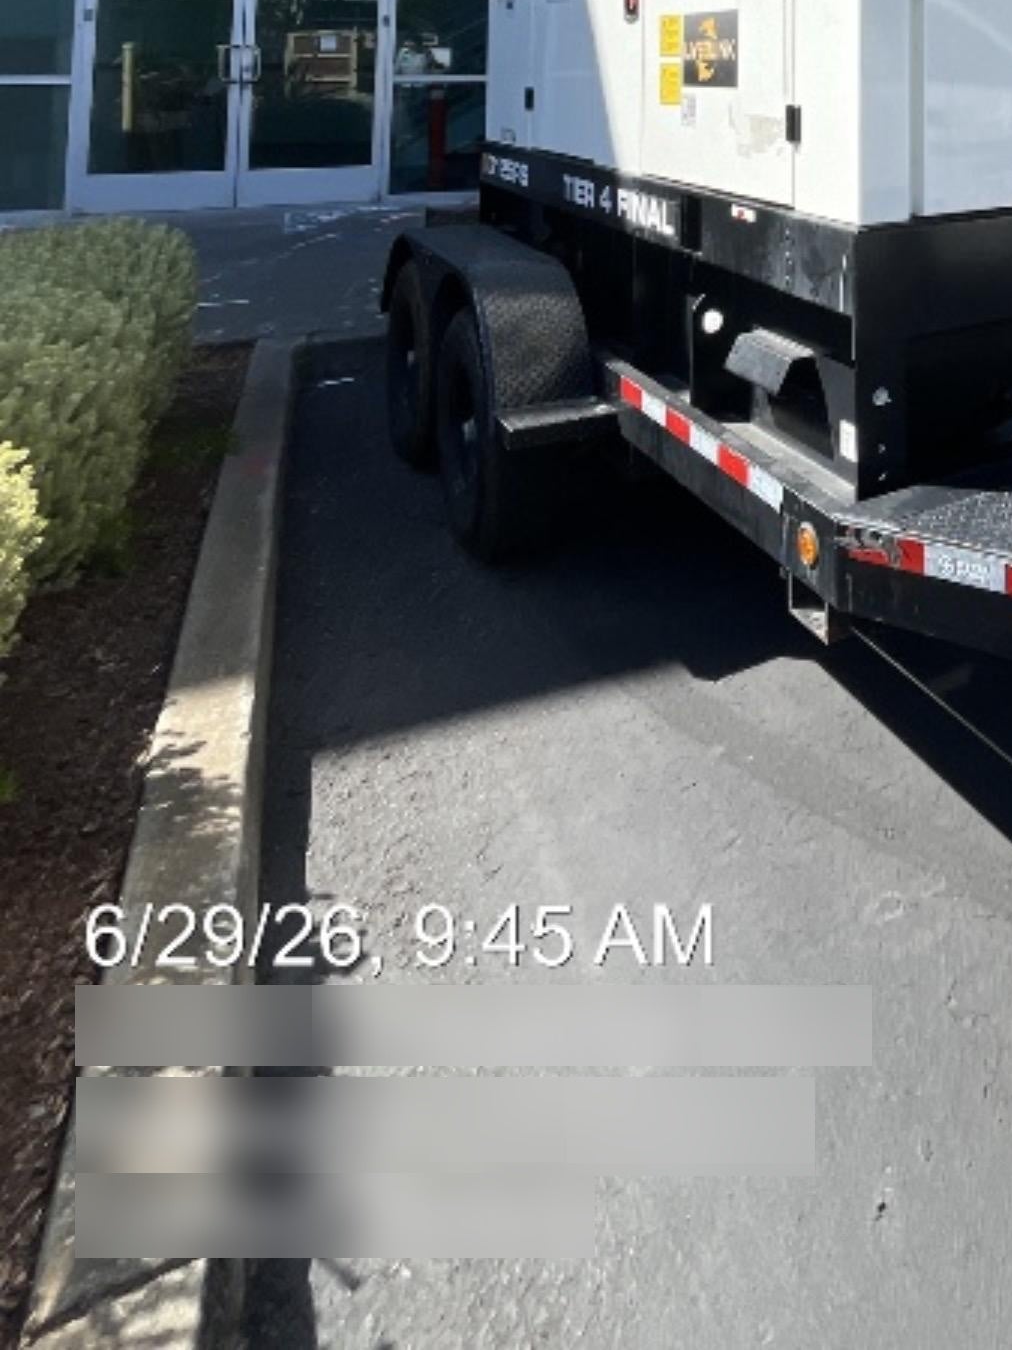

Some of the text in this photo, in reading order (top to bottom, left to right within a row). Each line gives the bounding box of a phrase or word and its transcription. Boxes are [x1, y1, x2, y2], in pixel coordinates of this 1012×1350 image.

[563, 173, 676, 236] TIER 4 FINAL
